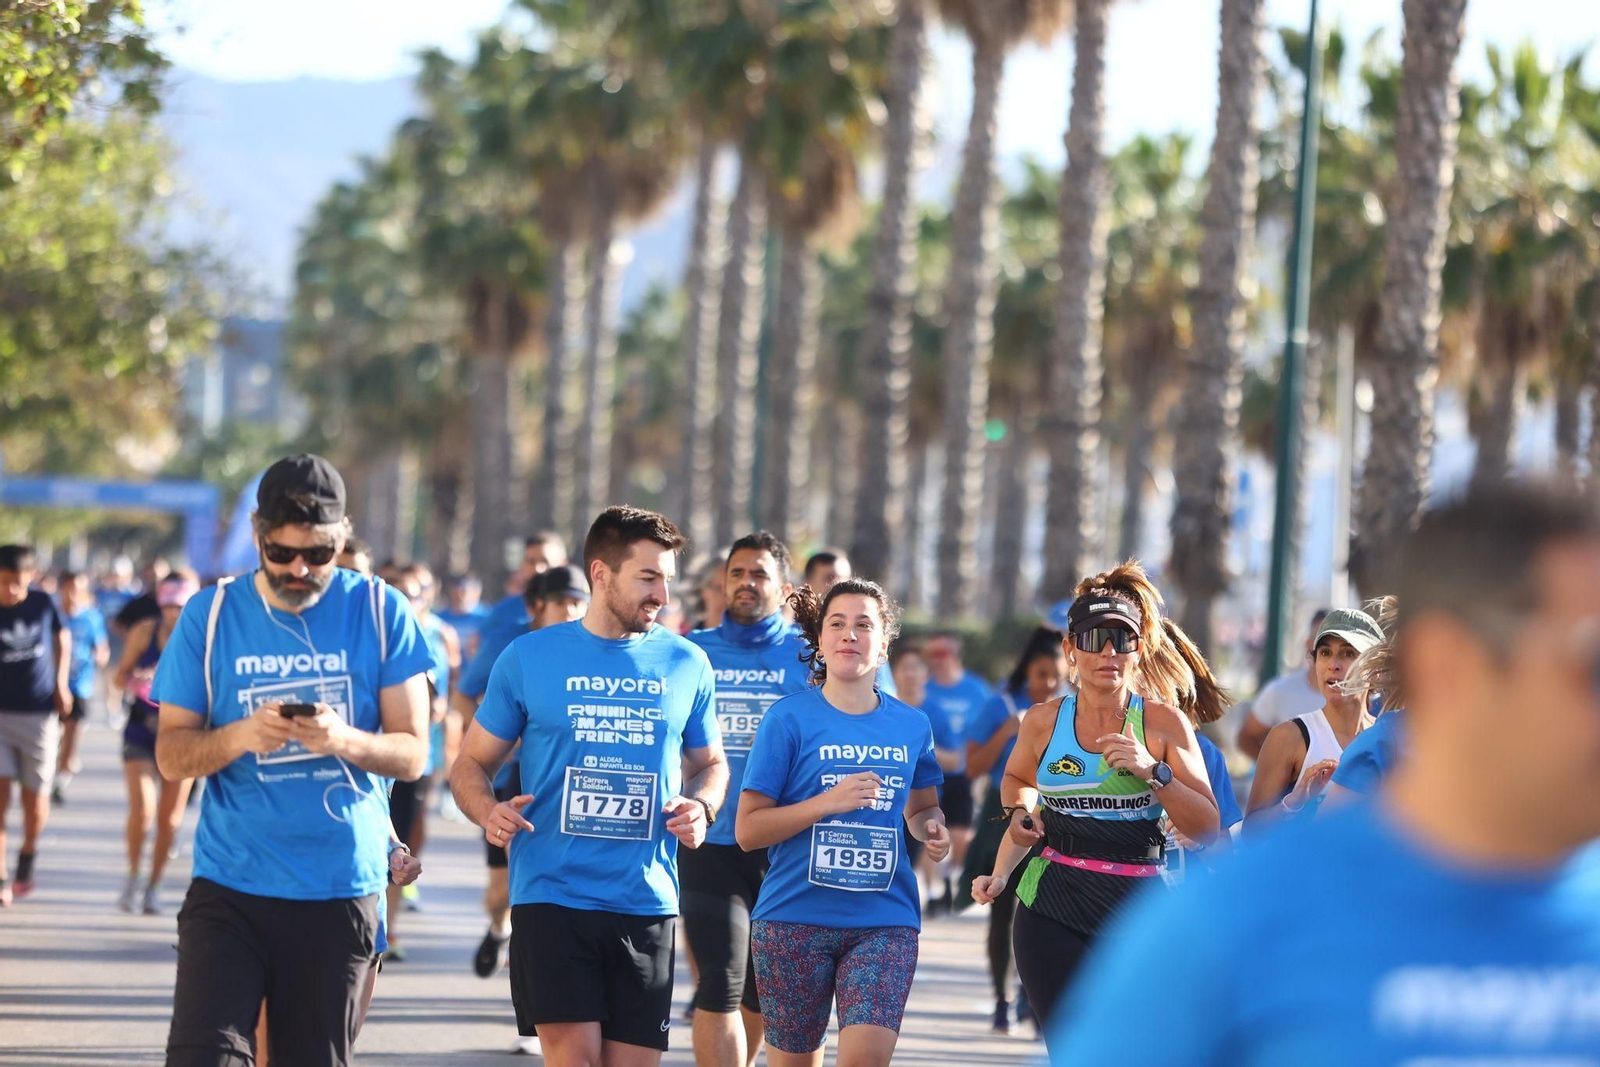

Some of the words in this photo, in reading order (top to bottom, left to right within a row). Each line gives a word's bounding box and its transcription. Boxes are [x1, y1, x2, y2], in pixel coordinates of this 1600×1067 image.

[235, 648, 347, 677] mayoral
[566, 676, 668, 697] mayoral
[567, 705, 663, 721] RUNNING
[577, 717, 655, 733] MAKES
[574, 730, 656, 746] FRIENDS
[599, 756, 623, 764] ALDEAS
[819, 744, 909, 765] mayoral
[599, 763, 633, 771] INFANTILES
[582, 783, 613, 792] Solidaria
[583, 776, 609, 785] Carrera
[576, 795, 644, 818] 1778
[1042, 794, 1151, 810] TORREMOLINOS
[827, 837, 858, 845] Solidaria
[828, 831, 854, 839] Carrera
[869, 831, 894, 839] mayoral
[823, 848, 887, 870] 1935
